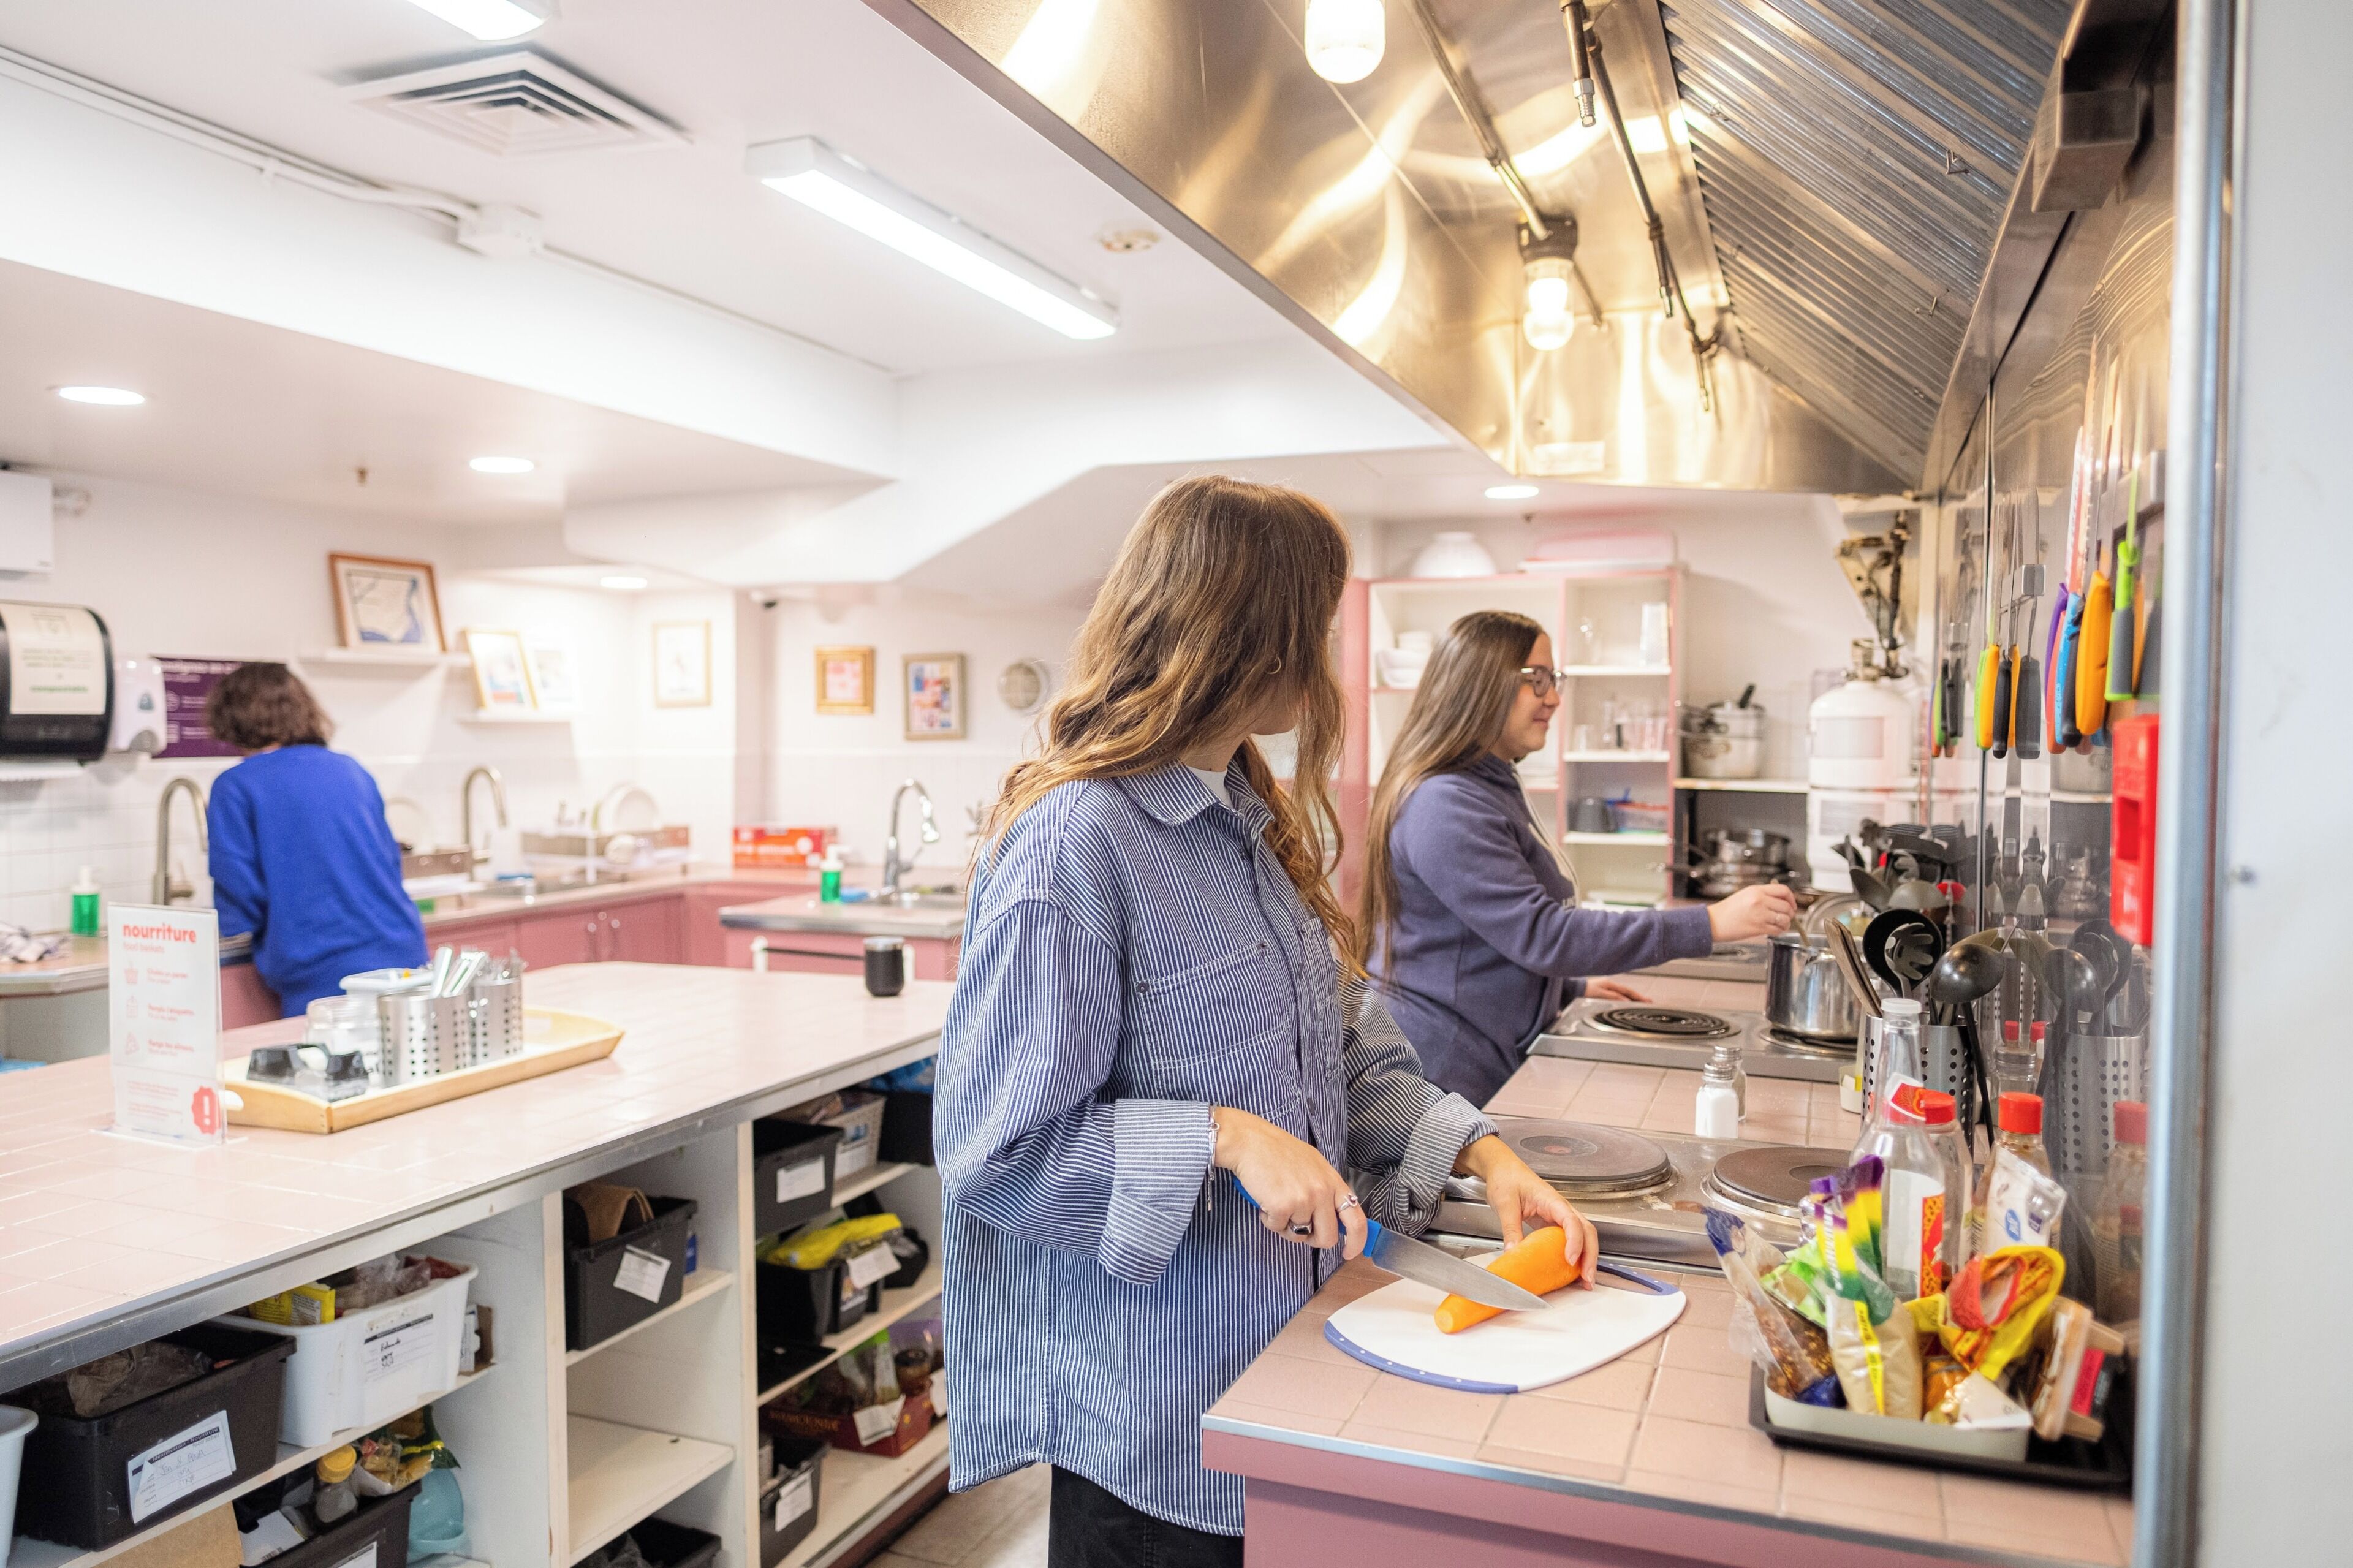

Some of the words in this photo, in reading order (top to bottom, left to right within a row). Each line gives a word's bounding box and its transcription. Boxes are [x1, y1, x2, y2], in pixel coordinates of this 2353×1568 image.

[123, 922, 196, 944] nourriture
[153, 1441, 186, 1461] Identification
[191, 1428, 218, 1442] Nourriture
